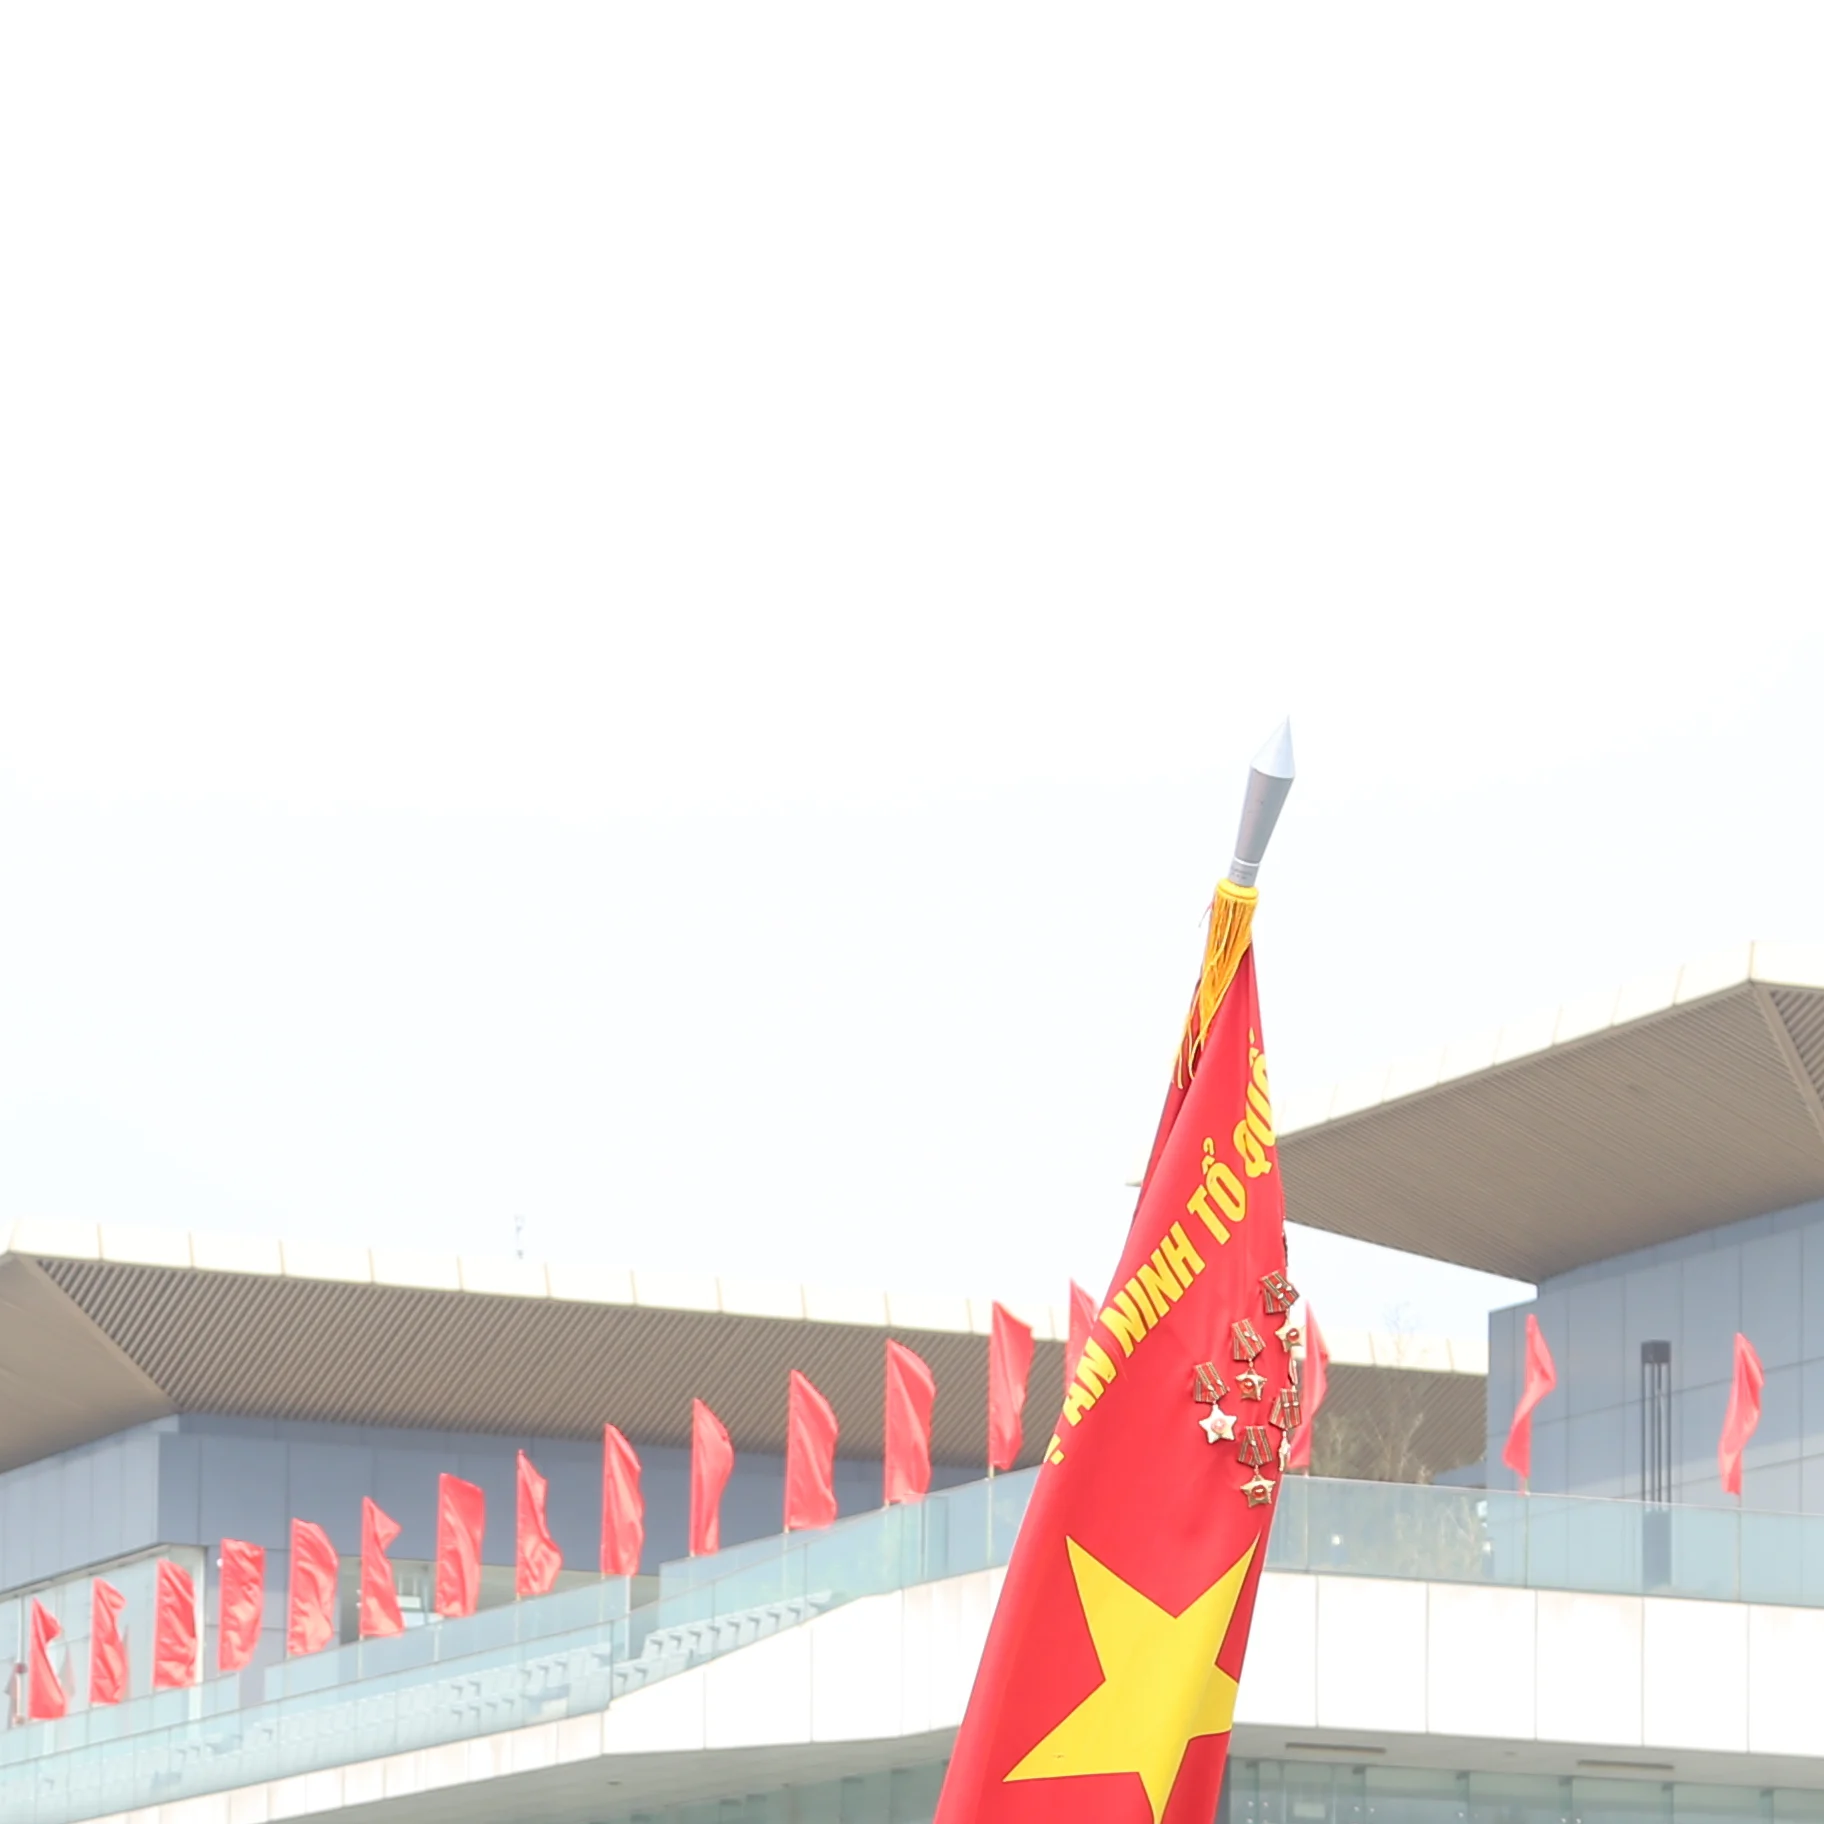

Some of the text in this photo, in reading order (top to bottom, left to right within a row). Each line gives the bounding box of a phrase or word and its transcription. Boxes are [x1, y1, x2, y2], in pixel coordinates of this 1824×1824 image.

[1063, 1336, 1117, 1427] AN
[1099, 1221, 1206, 1358] NINH
[1186, 1137, 1247, 1245] TỔ
